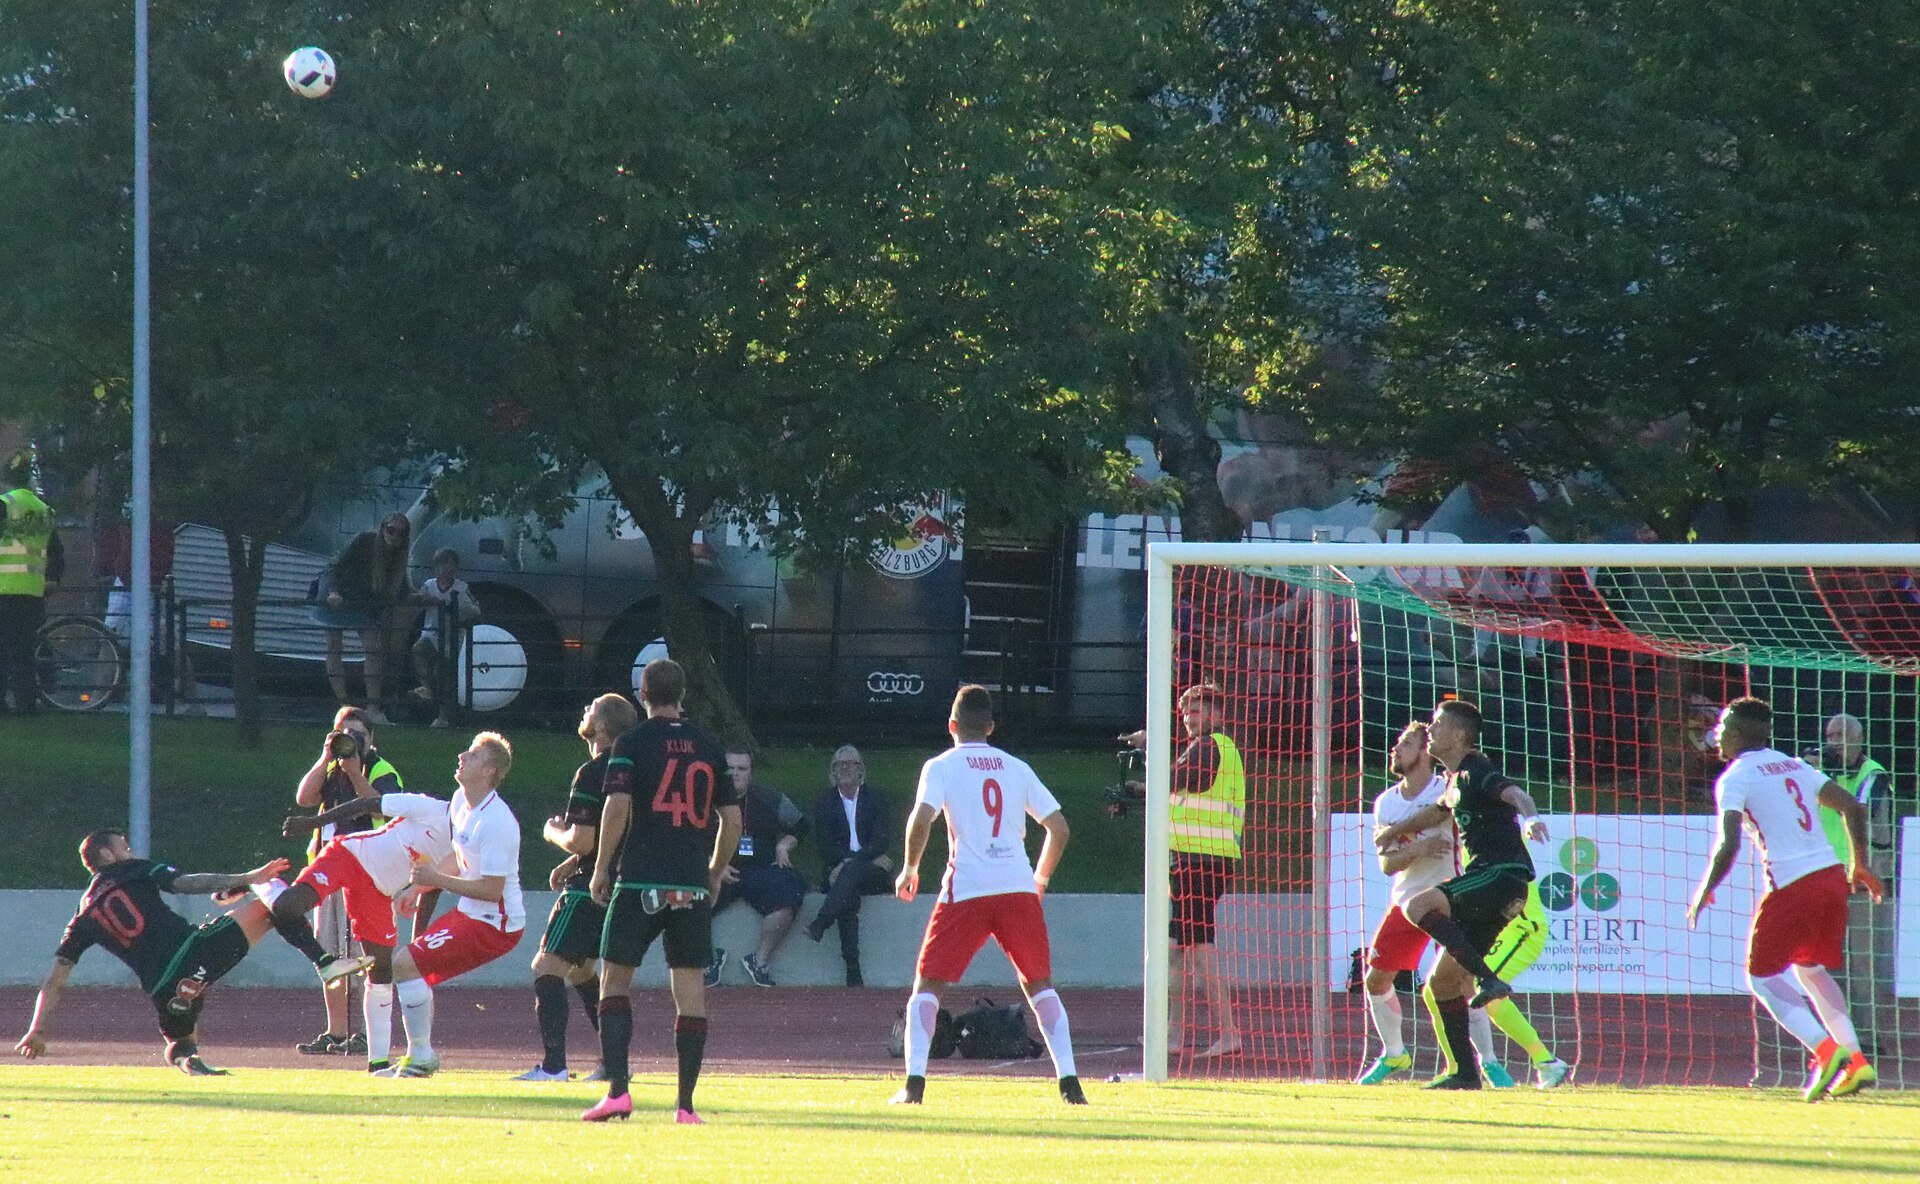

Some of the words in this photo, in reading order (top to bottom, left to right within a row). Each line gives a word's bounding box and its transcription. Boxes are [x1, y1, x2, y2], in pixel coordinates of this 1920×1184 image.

[966, 756, 1004, 770] DABBUR
[652, 758, 715, 828] 40
[982, 778, 1003, 837] 9
[1785, 777, 1812, 832] 3
[1575, 849, 1587, 864] P
[1552, 884, 1565, 899] N
[1595, 884, 1608, 899] K
[90, 888, 145, 948] 10
[424, 928, 453, 949] 36
[1578, 944, 1632, 955] fertilizers
